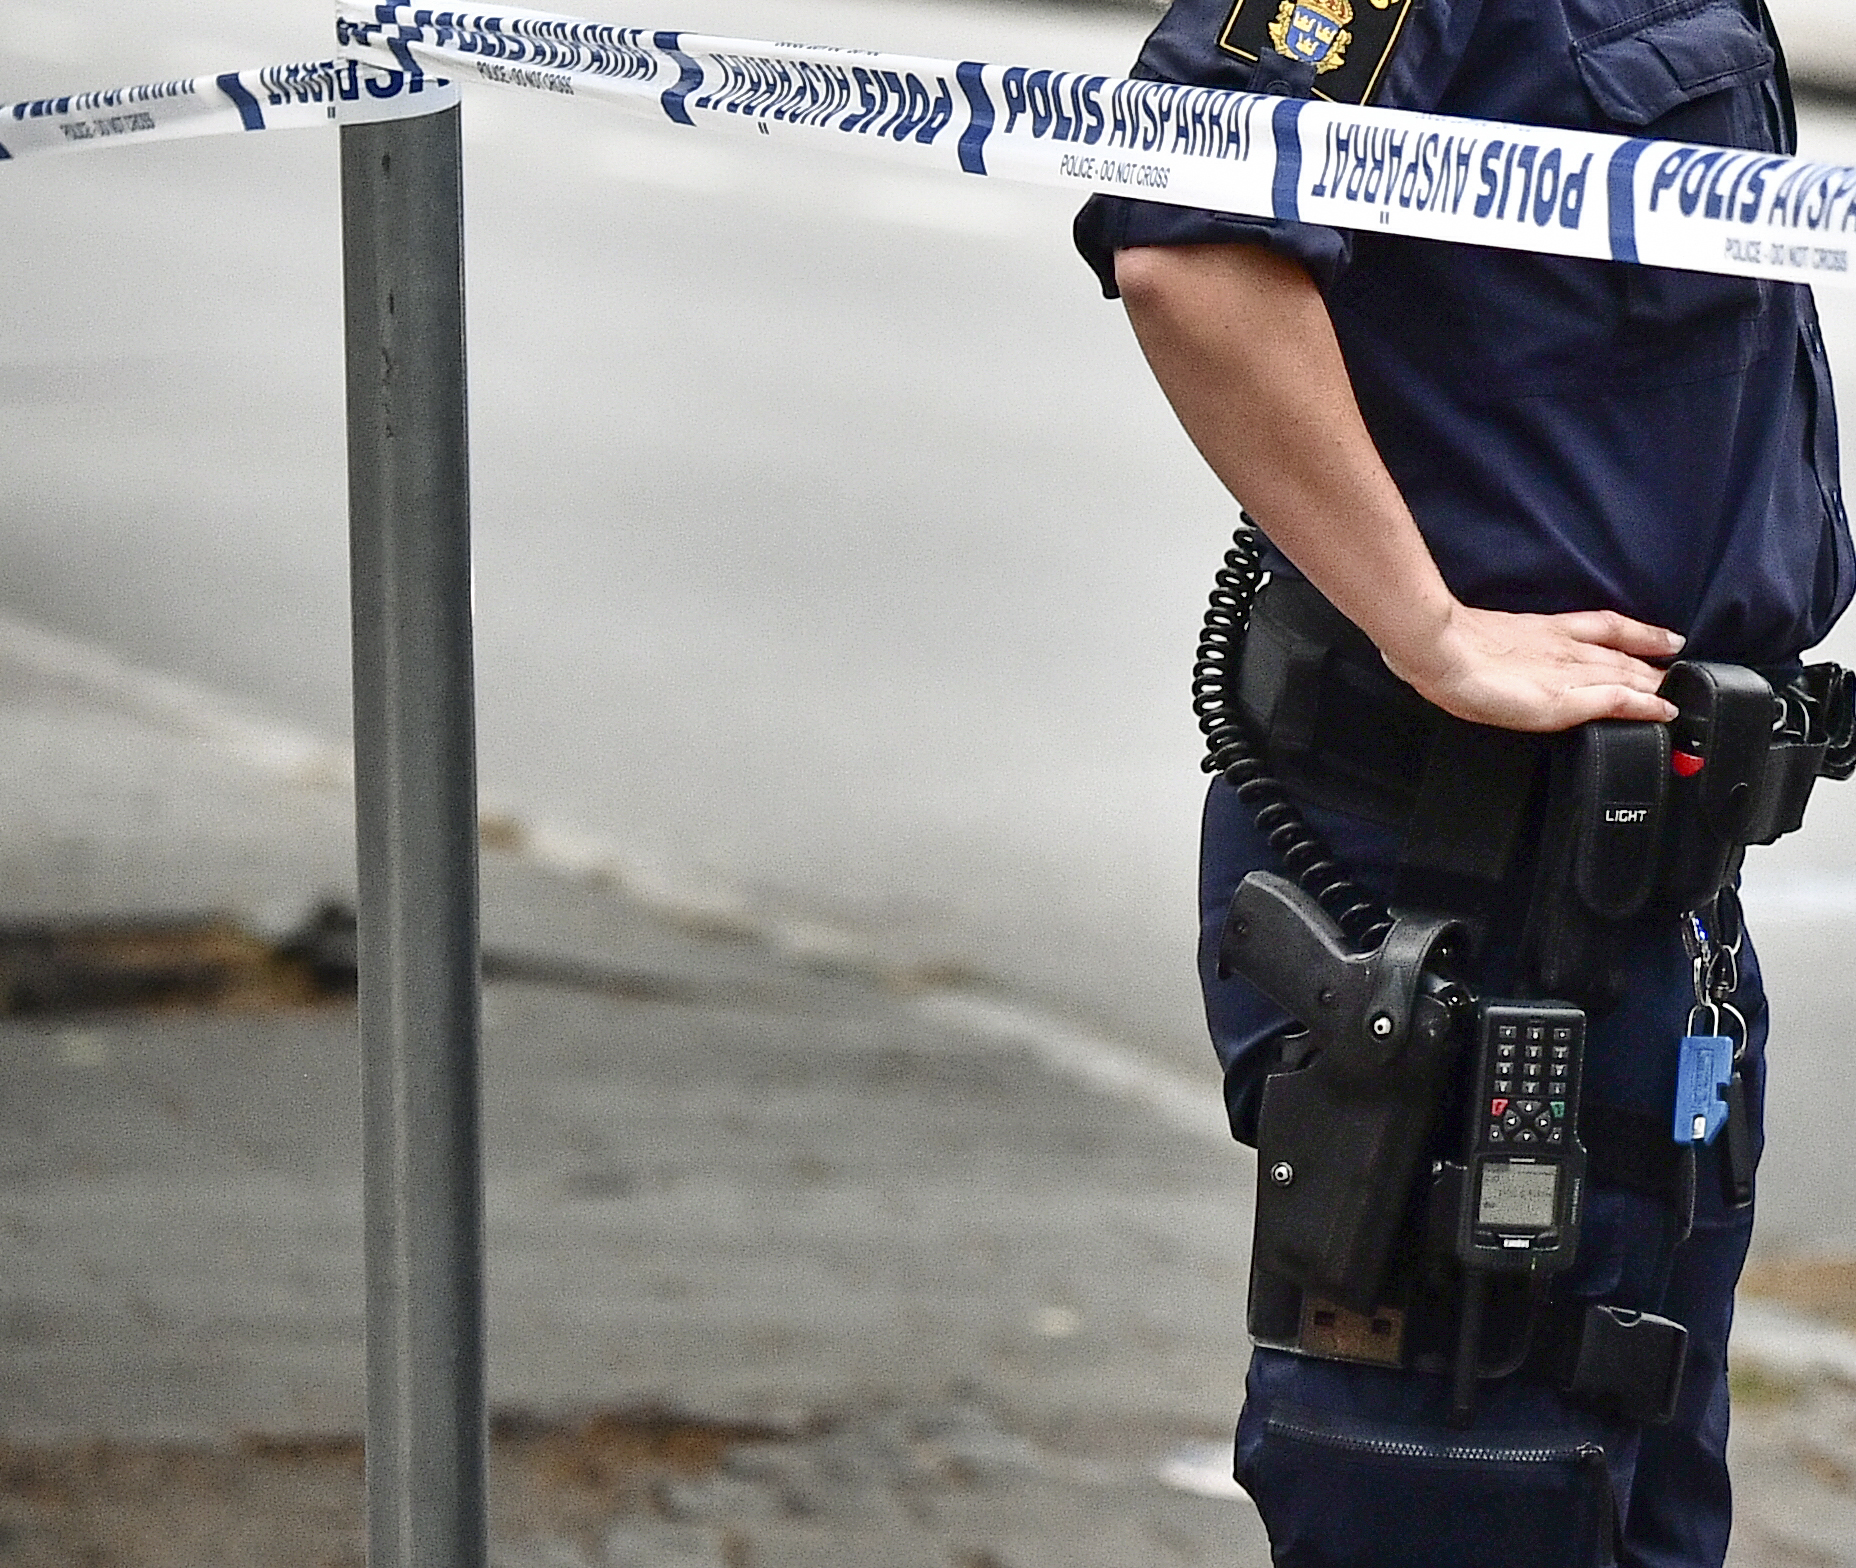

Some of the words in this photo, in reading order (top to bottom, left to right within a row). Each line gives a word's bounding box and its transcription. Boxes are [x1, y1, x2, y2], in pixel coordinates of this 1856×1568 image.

[838, 66, 953, 145] POLIS
[1002, 67, 1109, 145] POLIS
[1060, 154, 1096, 179] POLICE
[1100, 160, 1115, 181] DO
[1115, 162, 1138, 184] NOT
[1137, 165, 1171, 189] CROSS
[1473, 140, 1595, 230] POLIS
[1649, 147, 1791, 224] POLIS
[1605, 810, 1647, 822] LIGHT
